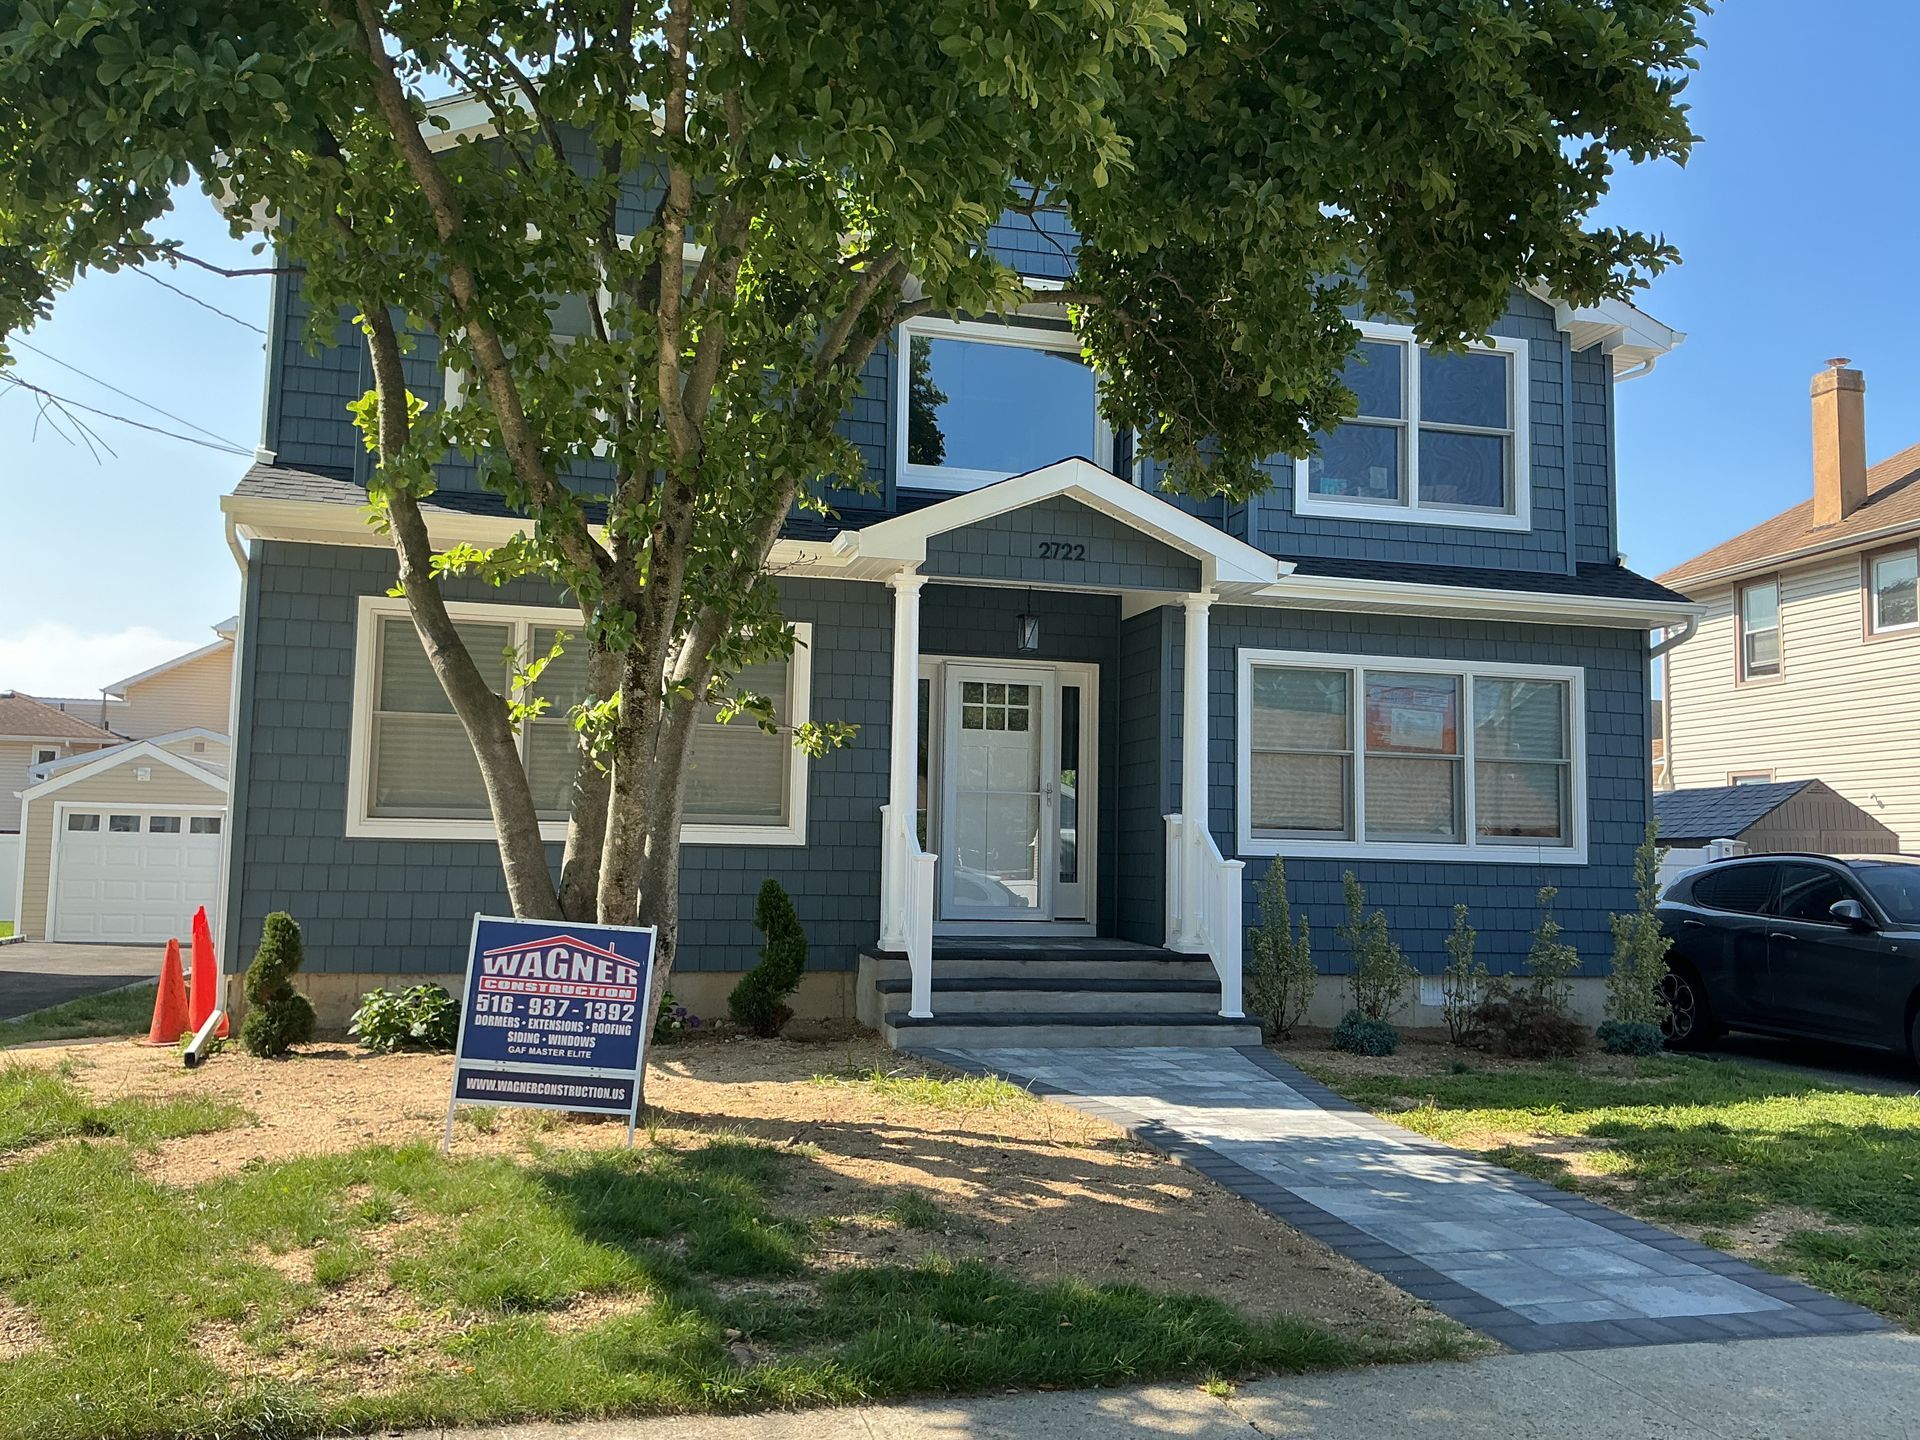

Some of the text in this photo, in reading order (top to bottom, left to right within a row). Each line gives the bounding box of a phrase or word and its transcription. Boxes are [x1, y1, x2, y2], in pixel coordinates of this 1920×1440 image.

[1039, 542, 1085, 561] 2722
[483, 947, 638, 985] WAGNER
[484, 979, 632, 998] CONSTRUCTION
[475, 1014, 632, 1036] DORMERS EXTENSIONS ROOFING
[507, 1031, 596, 1048] SIDING WINDOWS
[508, 1045, 592, 1059] GAF MASTER ELITE
[466, 1078, 625, 1101] WWW.WAGNERCONSTRUCTION.US
